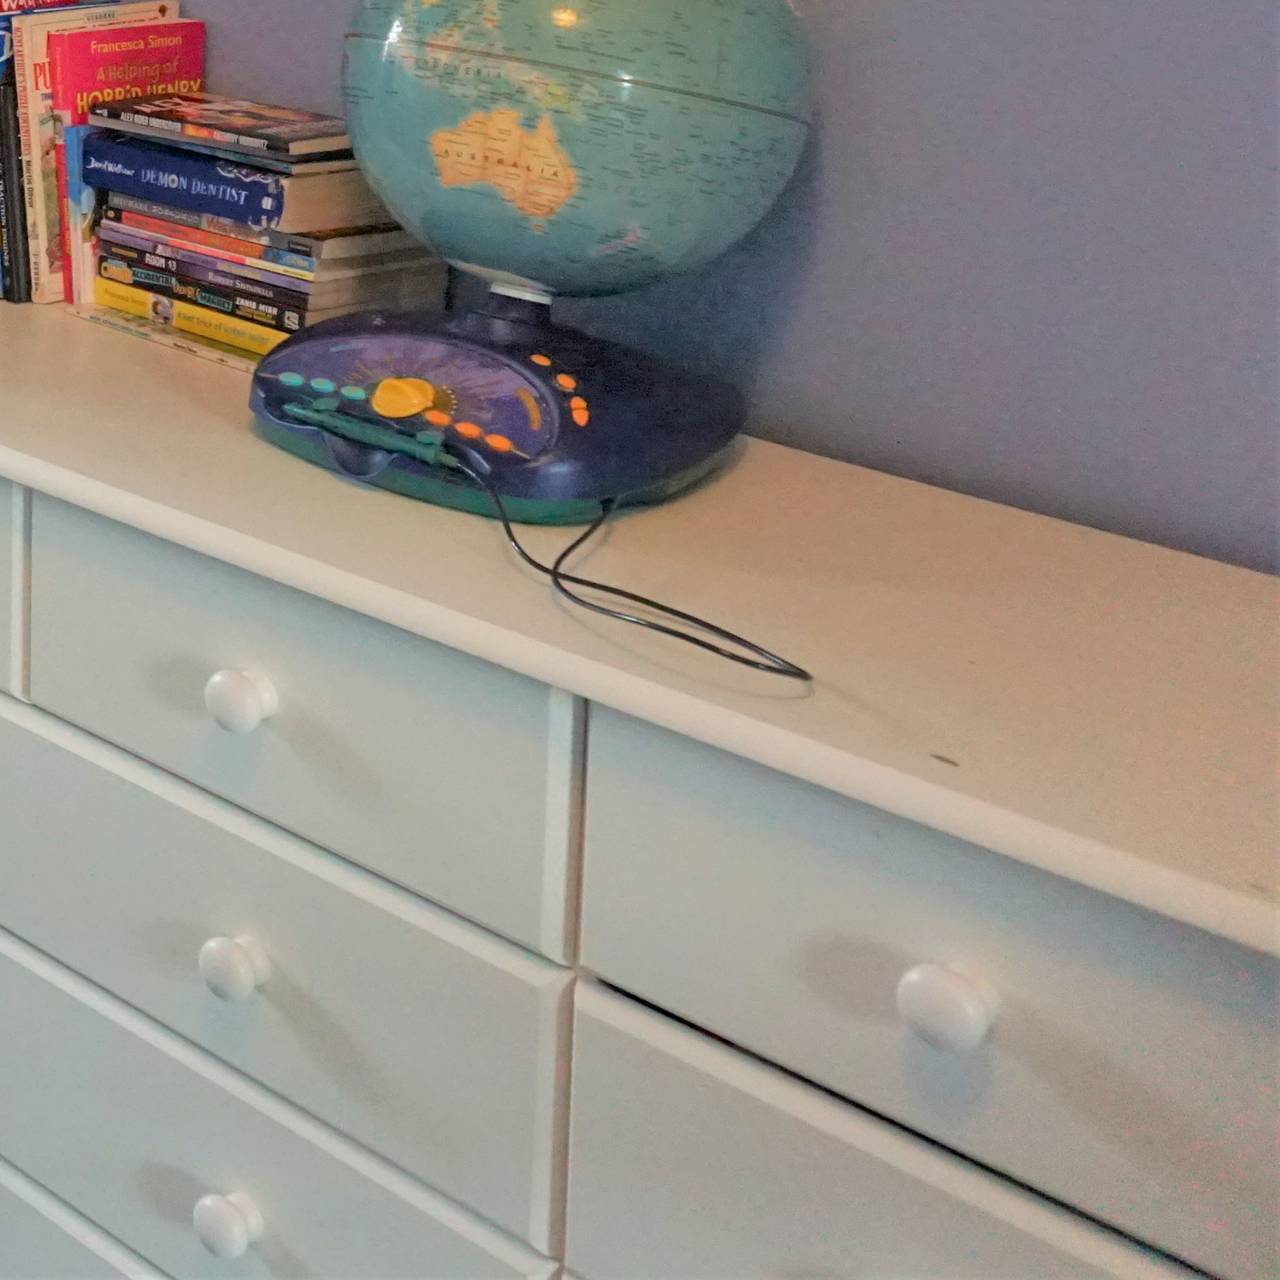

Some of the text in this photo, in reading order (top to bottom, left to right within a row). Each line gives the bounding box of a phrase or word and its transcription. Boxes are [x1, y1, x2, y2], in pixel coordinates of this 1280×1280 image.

[91, 34, 182, 54] Francesca Simon
[96, 56, 180, 84] A Helping of
[141, 169, 188, 191] DEMON
[192, 178, 249, 205] DENTIST
[145, 252, 177, 271] ROOM 13
